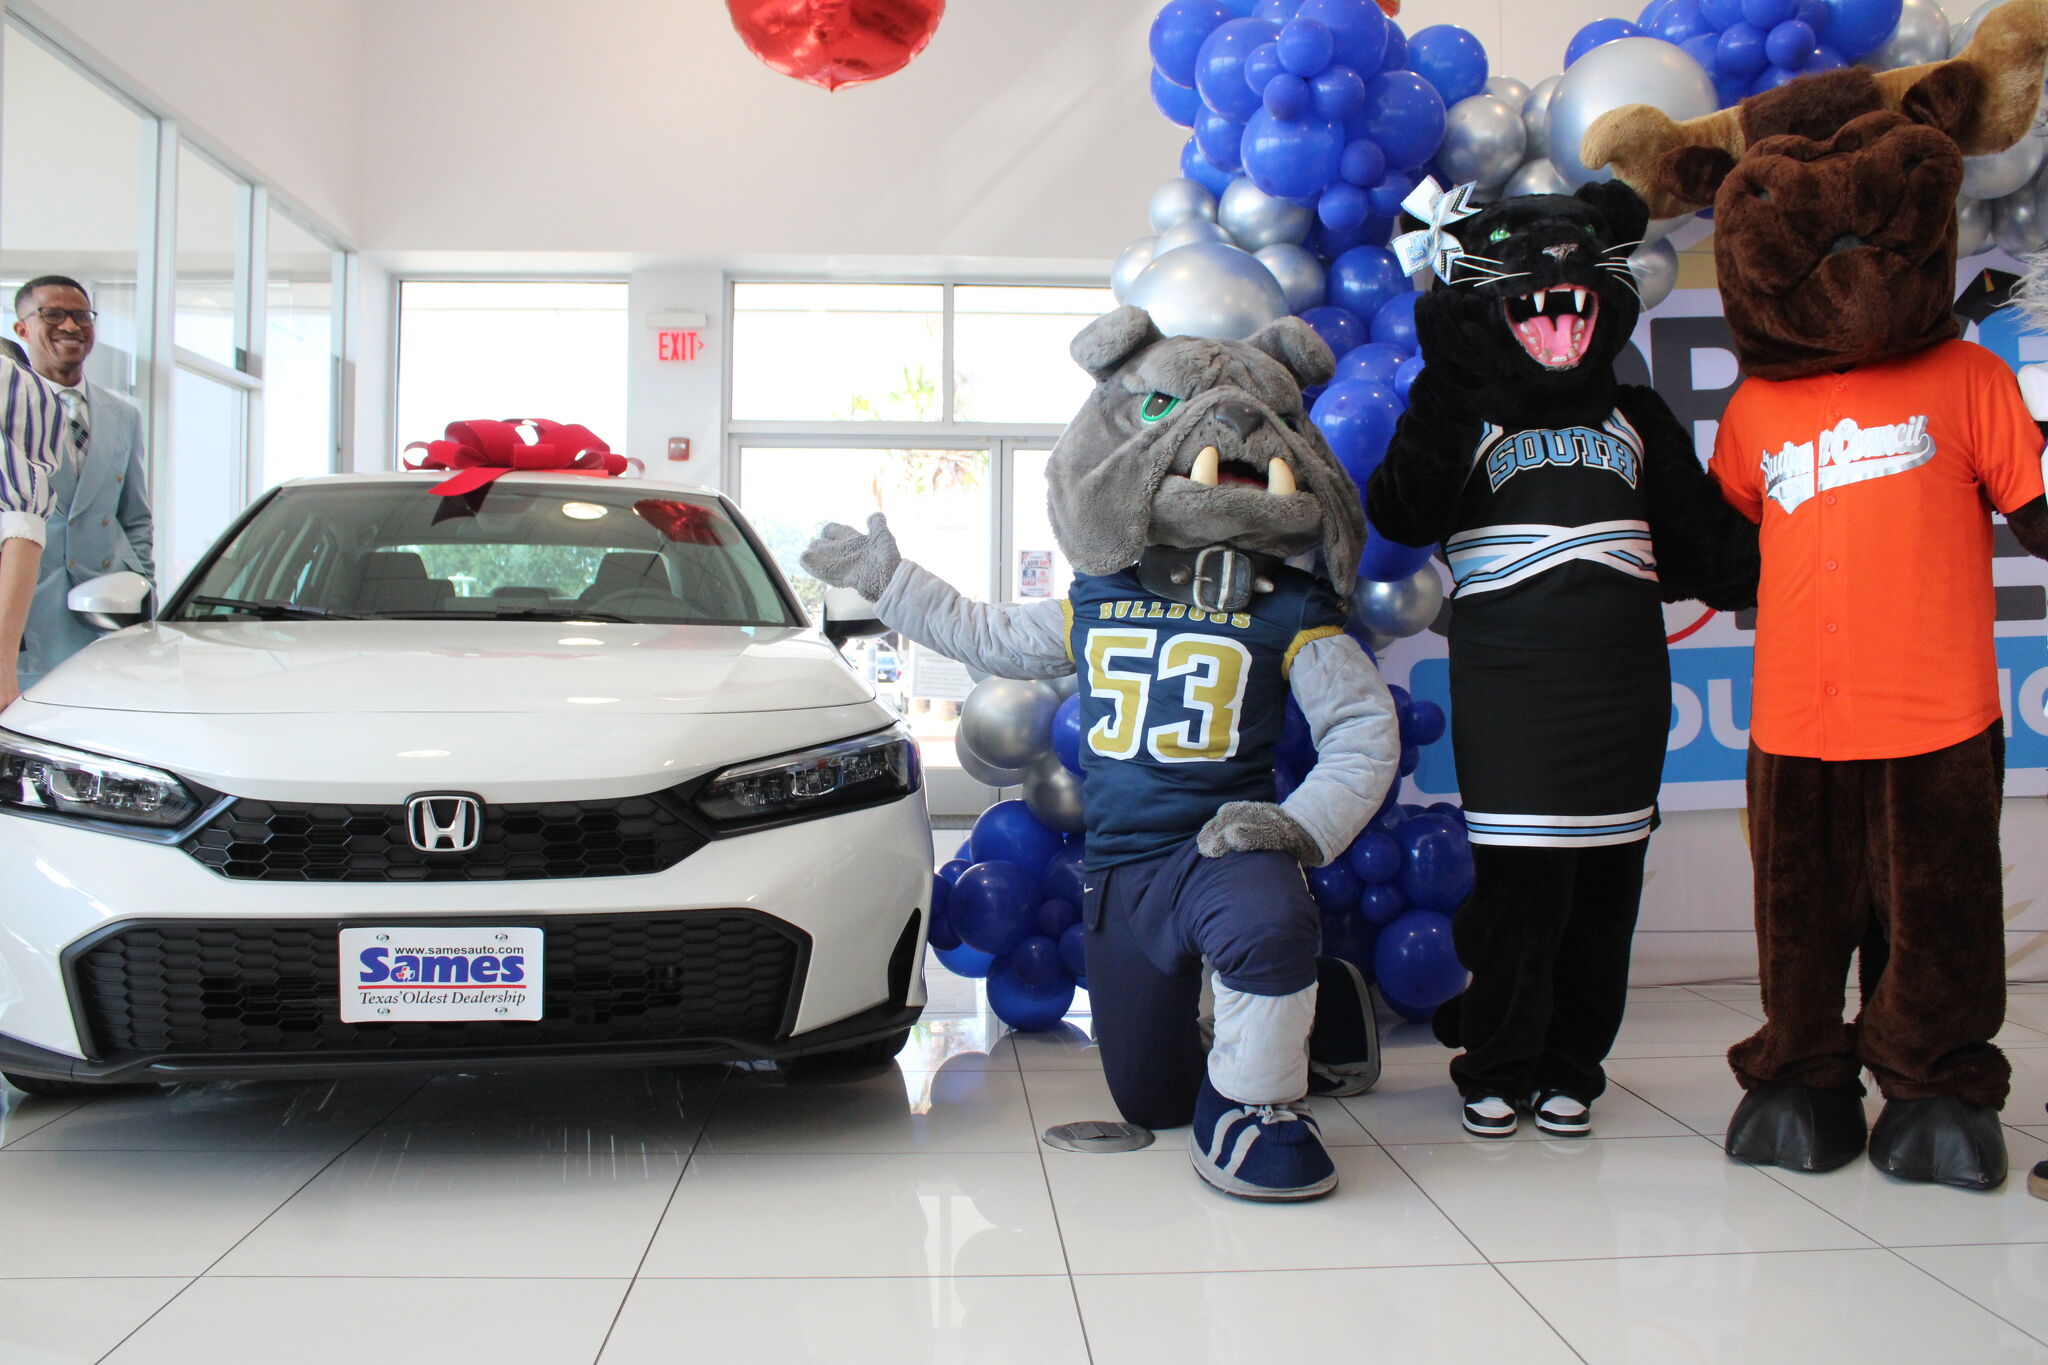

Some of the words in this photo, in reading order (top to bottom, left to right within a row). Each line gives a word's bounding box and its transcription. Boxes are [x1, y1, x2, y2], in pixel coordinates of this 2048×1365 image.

[658, 331, 697, 361] EXIT
[1832, 414, 1929, 465] Council
[1486, 426, 1637, 494] SOUTH
[1084, 627, 1253, 763] 53
[359, 946, 525, 983] Sames
[394, 945, 525, 955] www.samesauto.com
[451, 990, 527, 1007] Dealership
